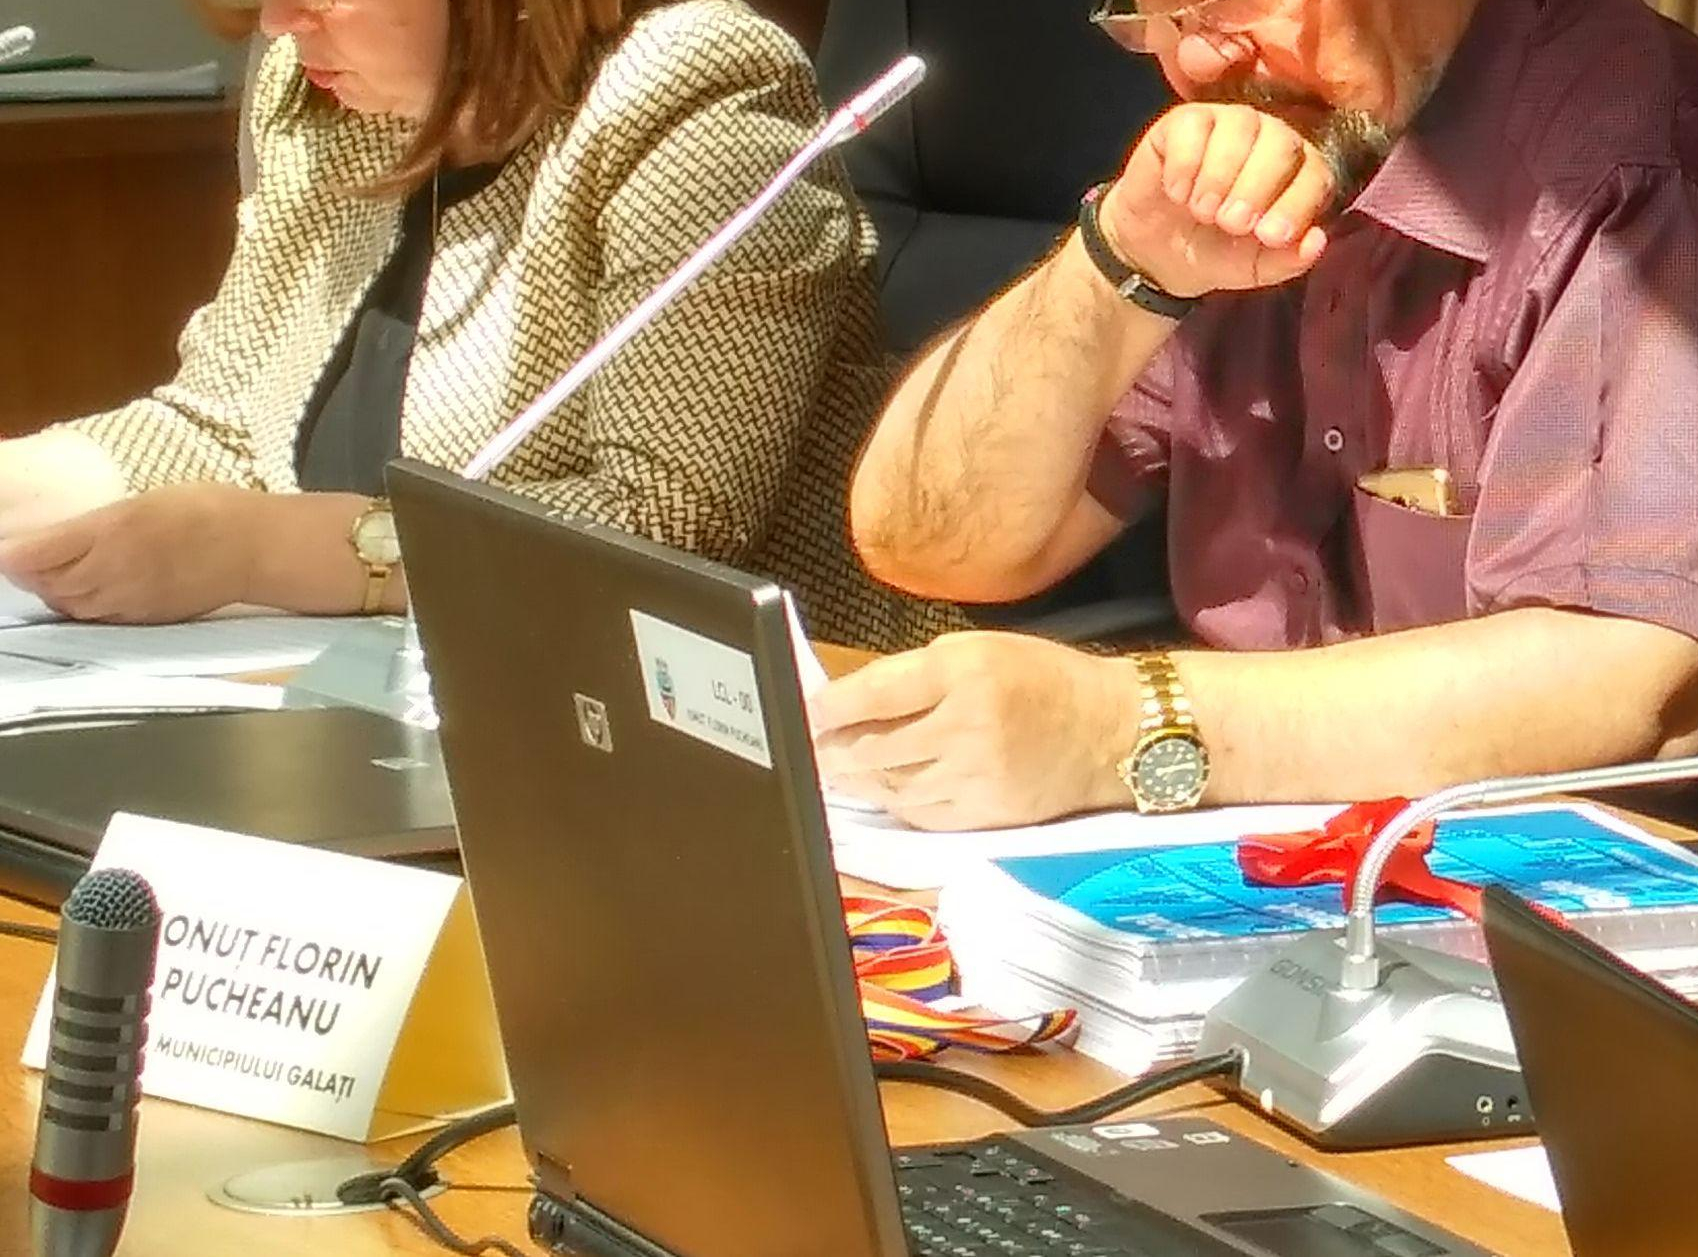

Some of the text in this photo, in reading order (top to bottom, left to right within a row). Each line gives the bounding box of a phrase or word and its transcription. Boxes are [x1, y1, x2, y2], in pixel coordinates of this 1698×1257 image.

[163, 915, 383, 990] ONUȚ FLORIN
[160, 966, 342, 1036] PUCHEANU
[155, 1034, 285, 1082] MUNICIPIULUI
